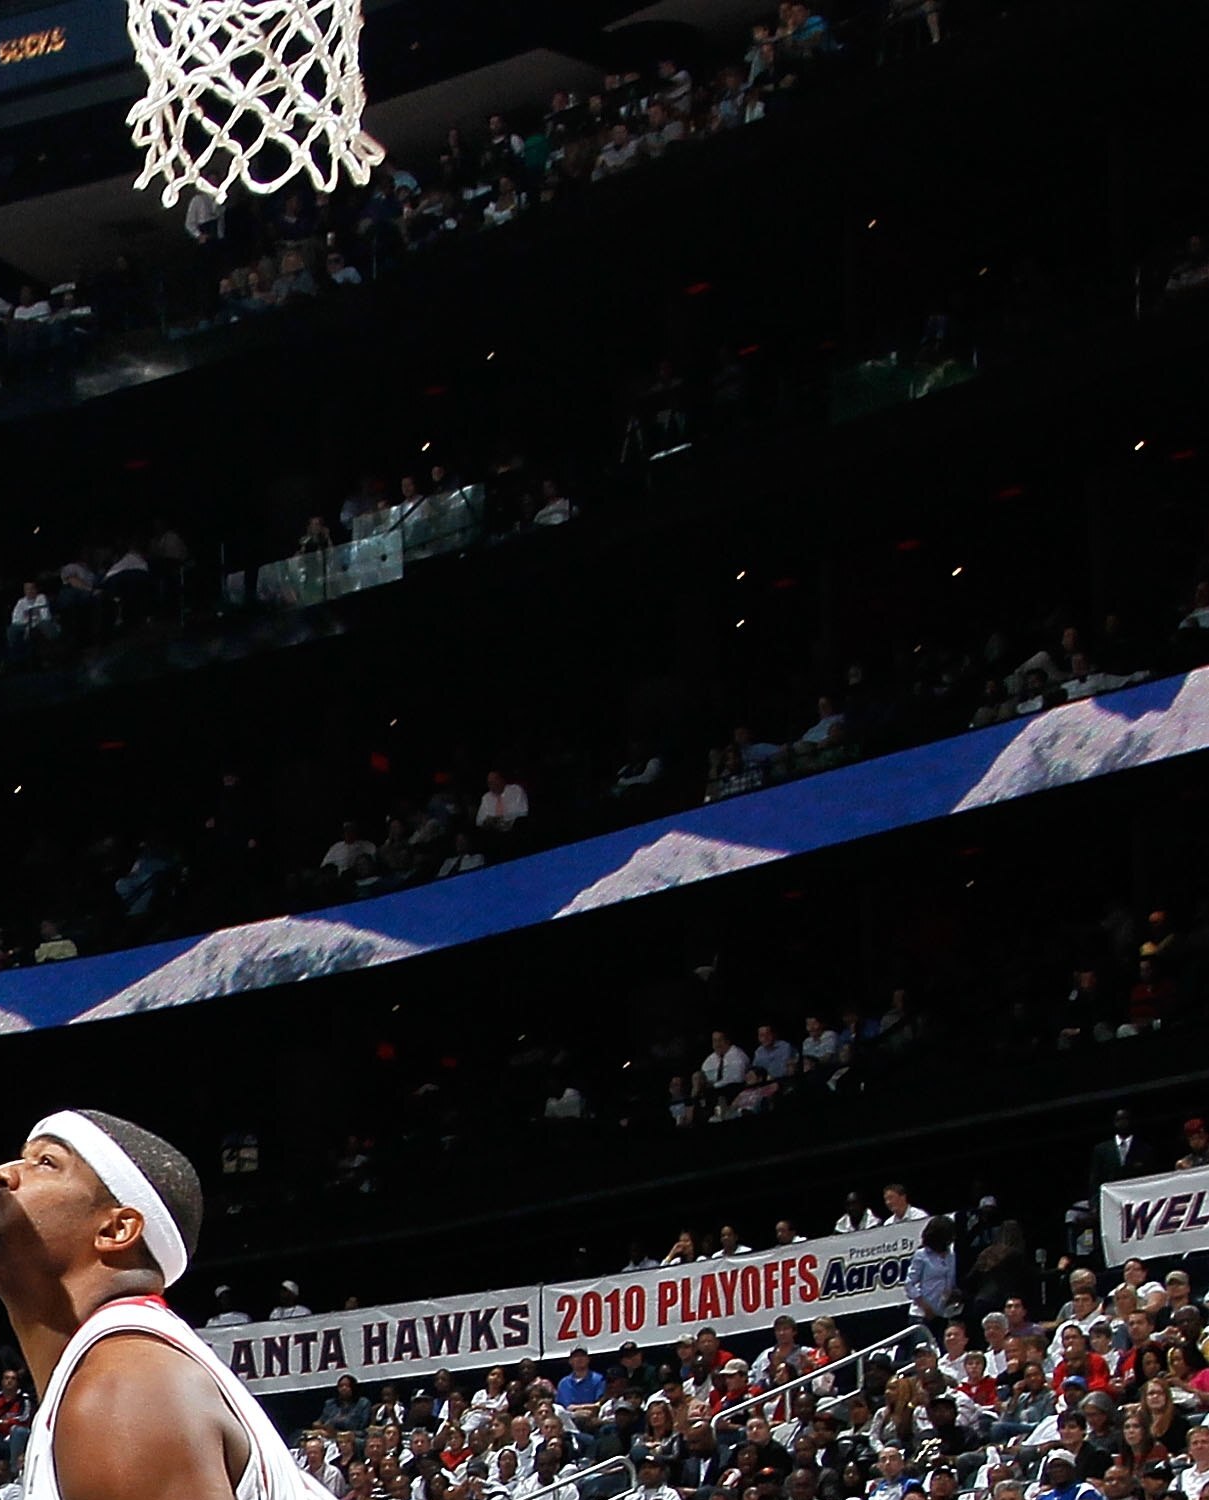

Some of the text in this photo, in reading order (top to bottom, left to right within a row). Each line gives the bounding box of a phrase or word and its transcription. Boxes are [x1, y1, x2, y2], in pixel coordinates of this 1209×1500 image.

[849, 1238, 915, 1259] Presented By
[1120, 1190, 1209, 1244] WEL
[556, 1254, 820, 1341] 2010 PLAYOFFS
[206, 1303, 531, 1381] ANTA HAWKS
